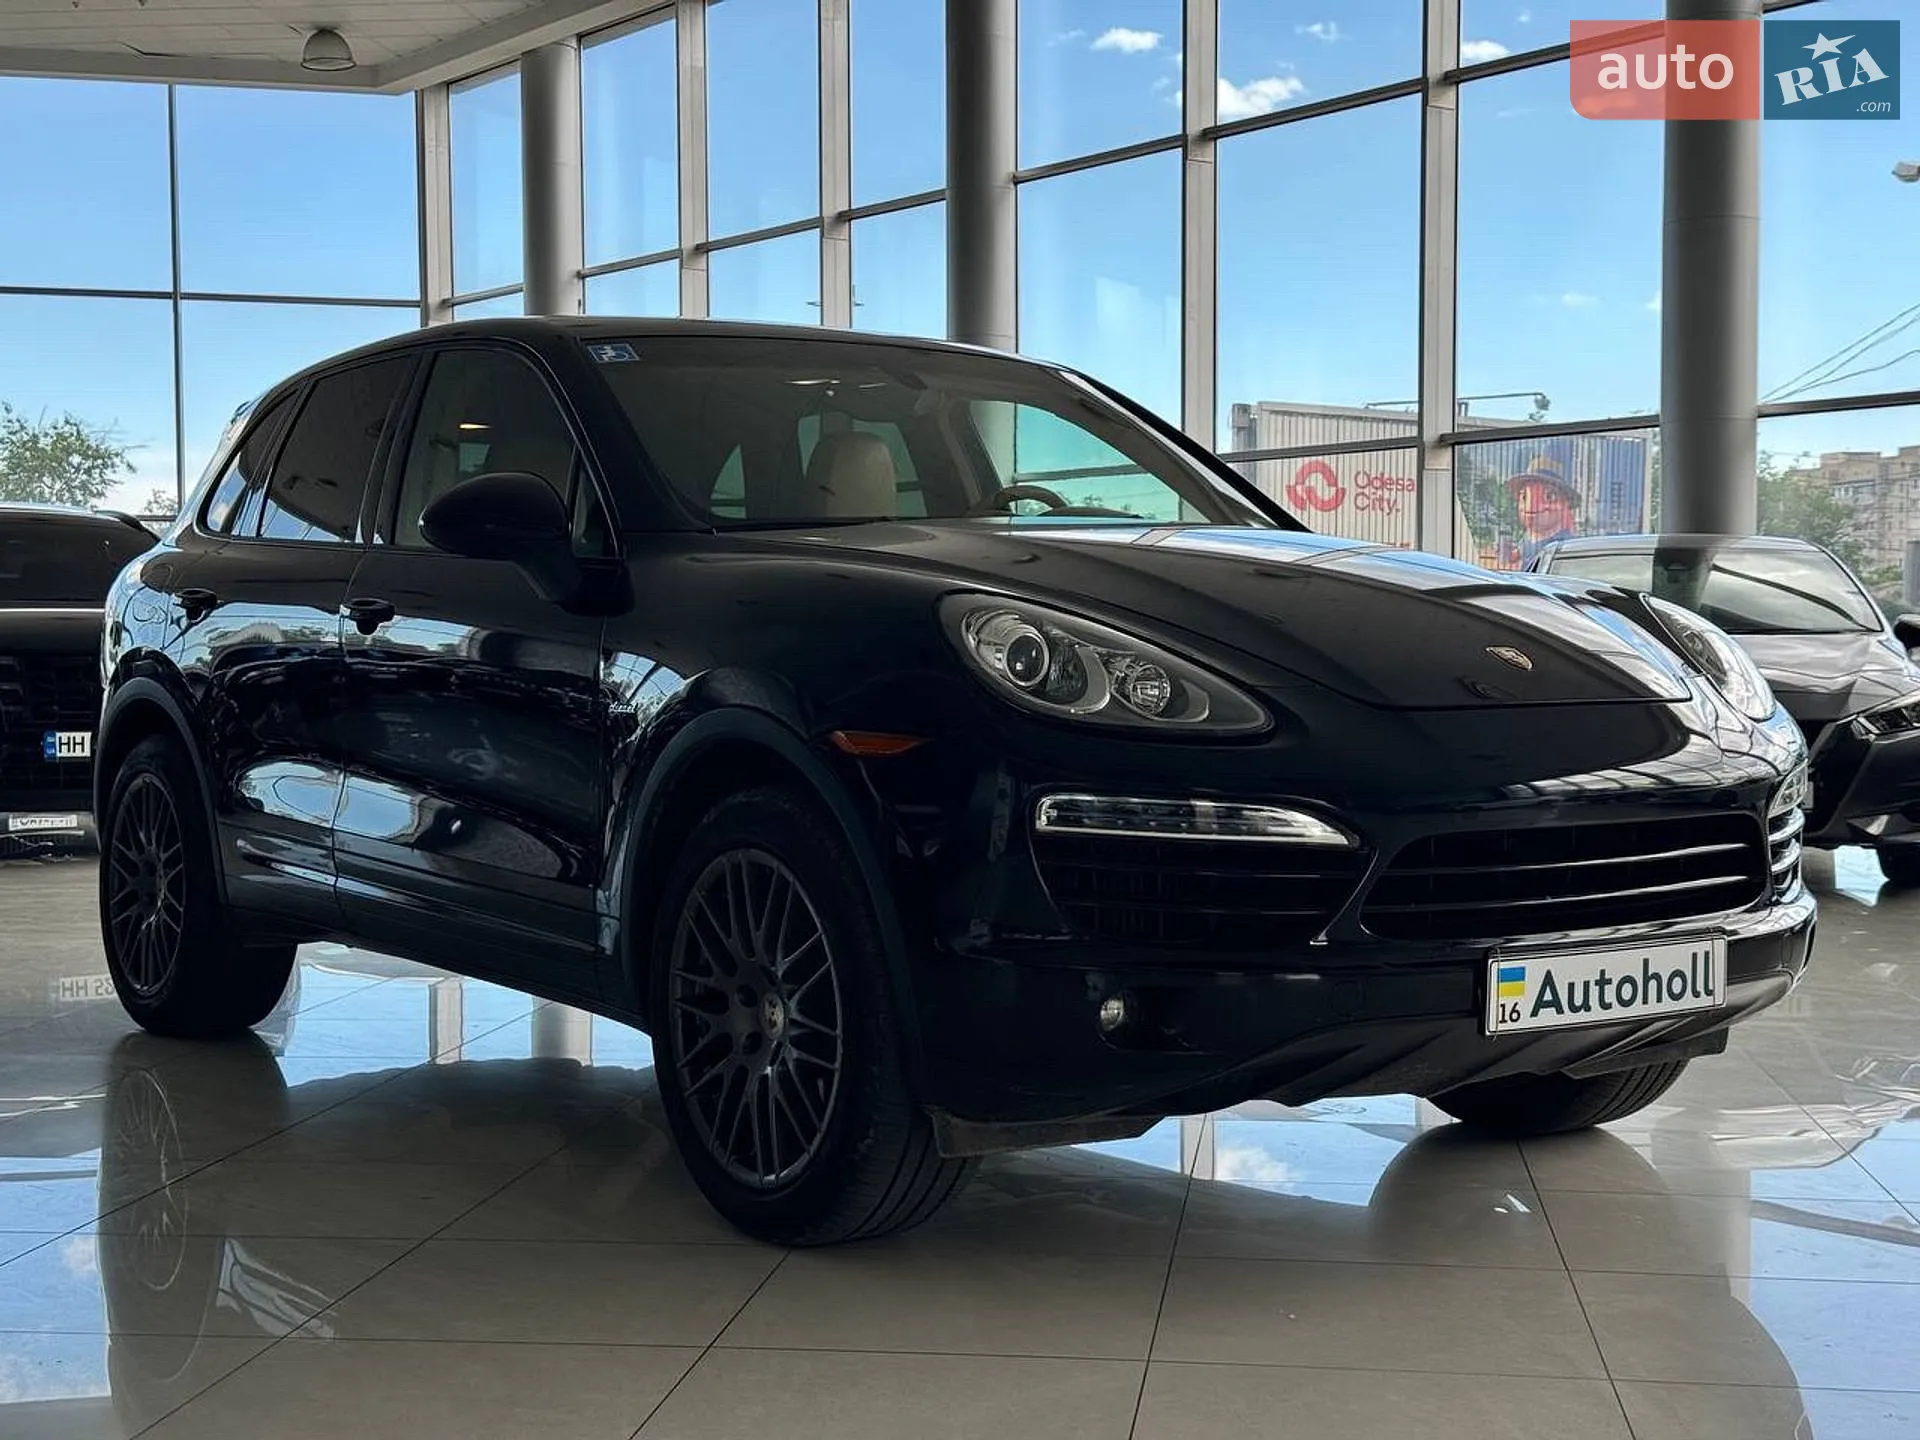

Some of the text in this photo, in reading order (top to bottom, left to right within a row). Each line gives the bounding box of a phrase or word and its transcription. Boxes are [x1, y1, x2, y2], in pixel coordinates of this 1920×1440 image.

[1355, 471, 1415, 493] Odesa
[58, 735, 86, 754] HH
[1530, 951, 1714, 1018] Autoholl
[1499, 1001, 1521, 1024] 16
